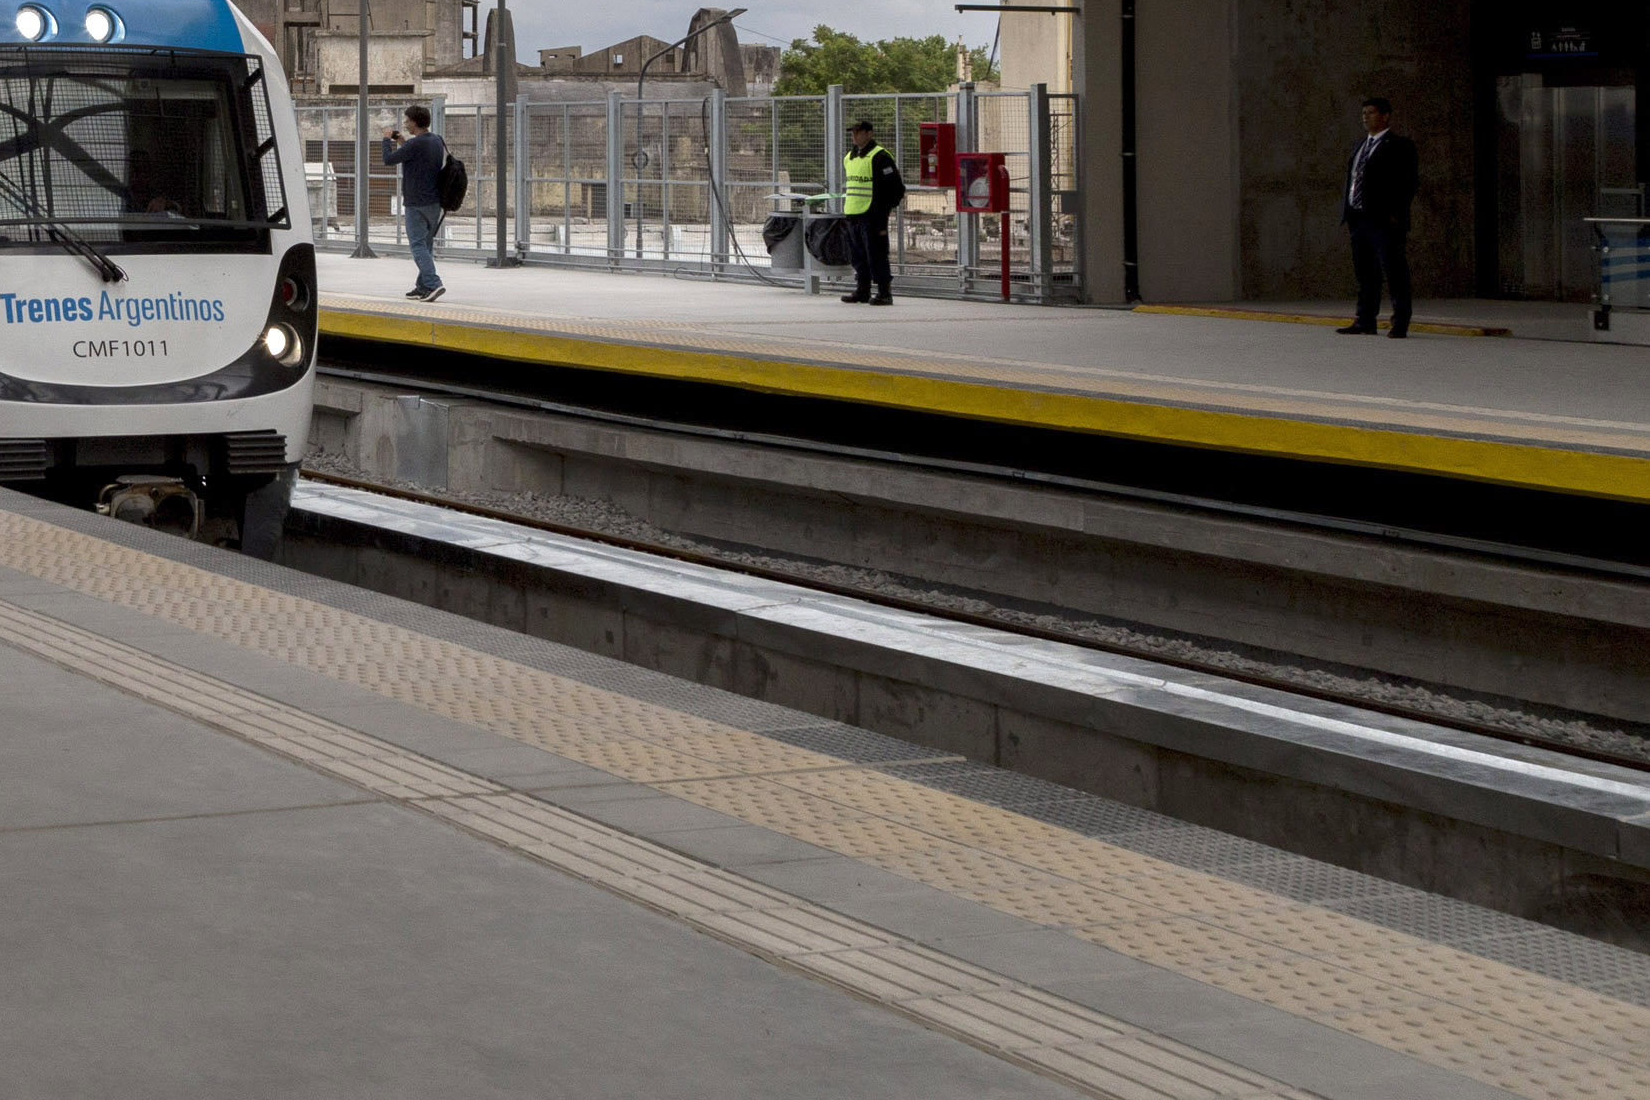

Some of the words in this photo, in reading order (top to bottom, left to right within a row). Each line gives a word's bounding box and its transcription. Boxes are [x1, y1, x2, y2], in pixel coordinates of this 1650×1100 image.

[0, 292, 93, 324] Trenes
[98, 290, 224, 327] Argentinos
[73, 340, 168, 358] CMF1011
